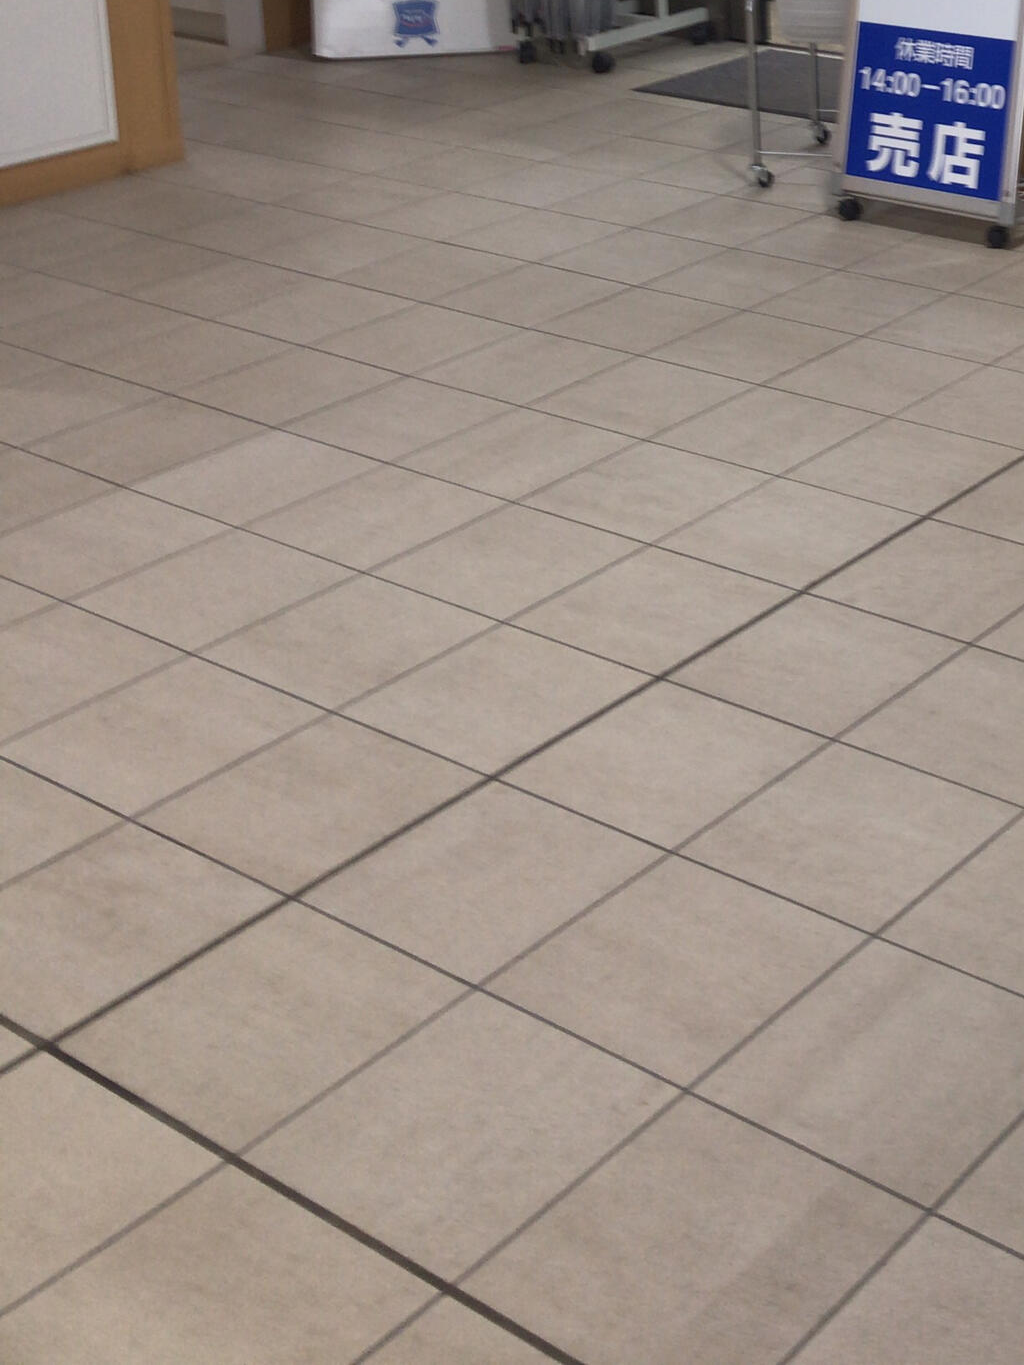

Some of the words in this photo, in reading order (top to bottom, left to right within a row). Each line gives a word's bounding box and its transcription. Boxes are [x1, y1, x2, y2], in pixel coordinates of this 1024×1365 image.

[894, 36, 975, 71] 休業時間
[866, 112, 986, 190] 売店
